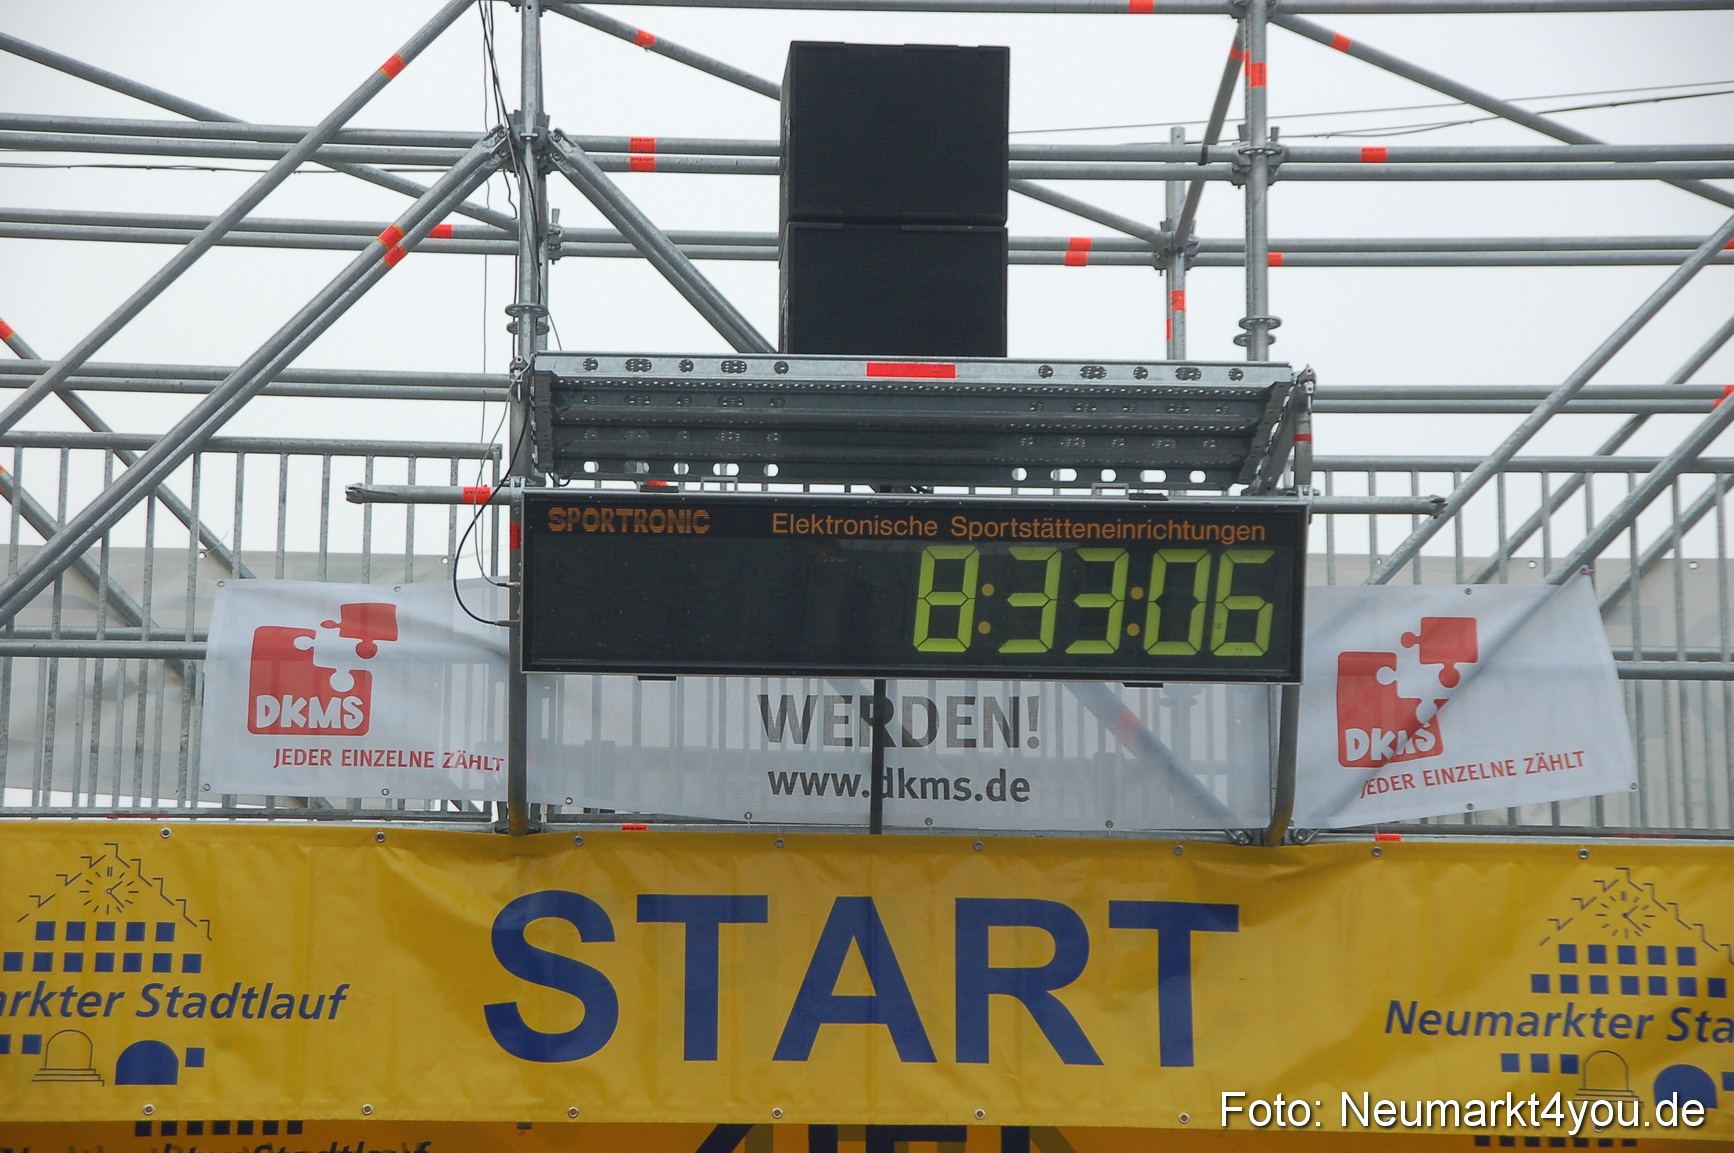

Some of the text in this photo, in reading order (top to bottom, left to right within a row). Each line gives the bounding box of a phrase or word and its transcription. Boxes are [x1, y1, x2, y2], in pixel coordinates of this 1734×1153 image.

[547, 507, 711, 534] SPORTRONIC
[772, 512, 1266, 545] Elektronische Sportstätteneinrichtungen
[913, 545, 1275, 656] 8:33:06
[256, 694, 364, 730] DKMS
[756, 694, 1040, 749] WERDEN!
[273, 748, 504, 772] JEDER EINZELNE ZÄHLT
[1360, 750, 1585, 799] JEDER EINZELNE ZÄHLT
[767, 766, 1031, 802] www.dkms.de
[483, 889, 1239, 1068] START
[135, 982, 351, 1020] Stadtlauf
[1384, 999, 1654, 1042] Neumarkter
